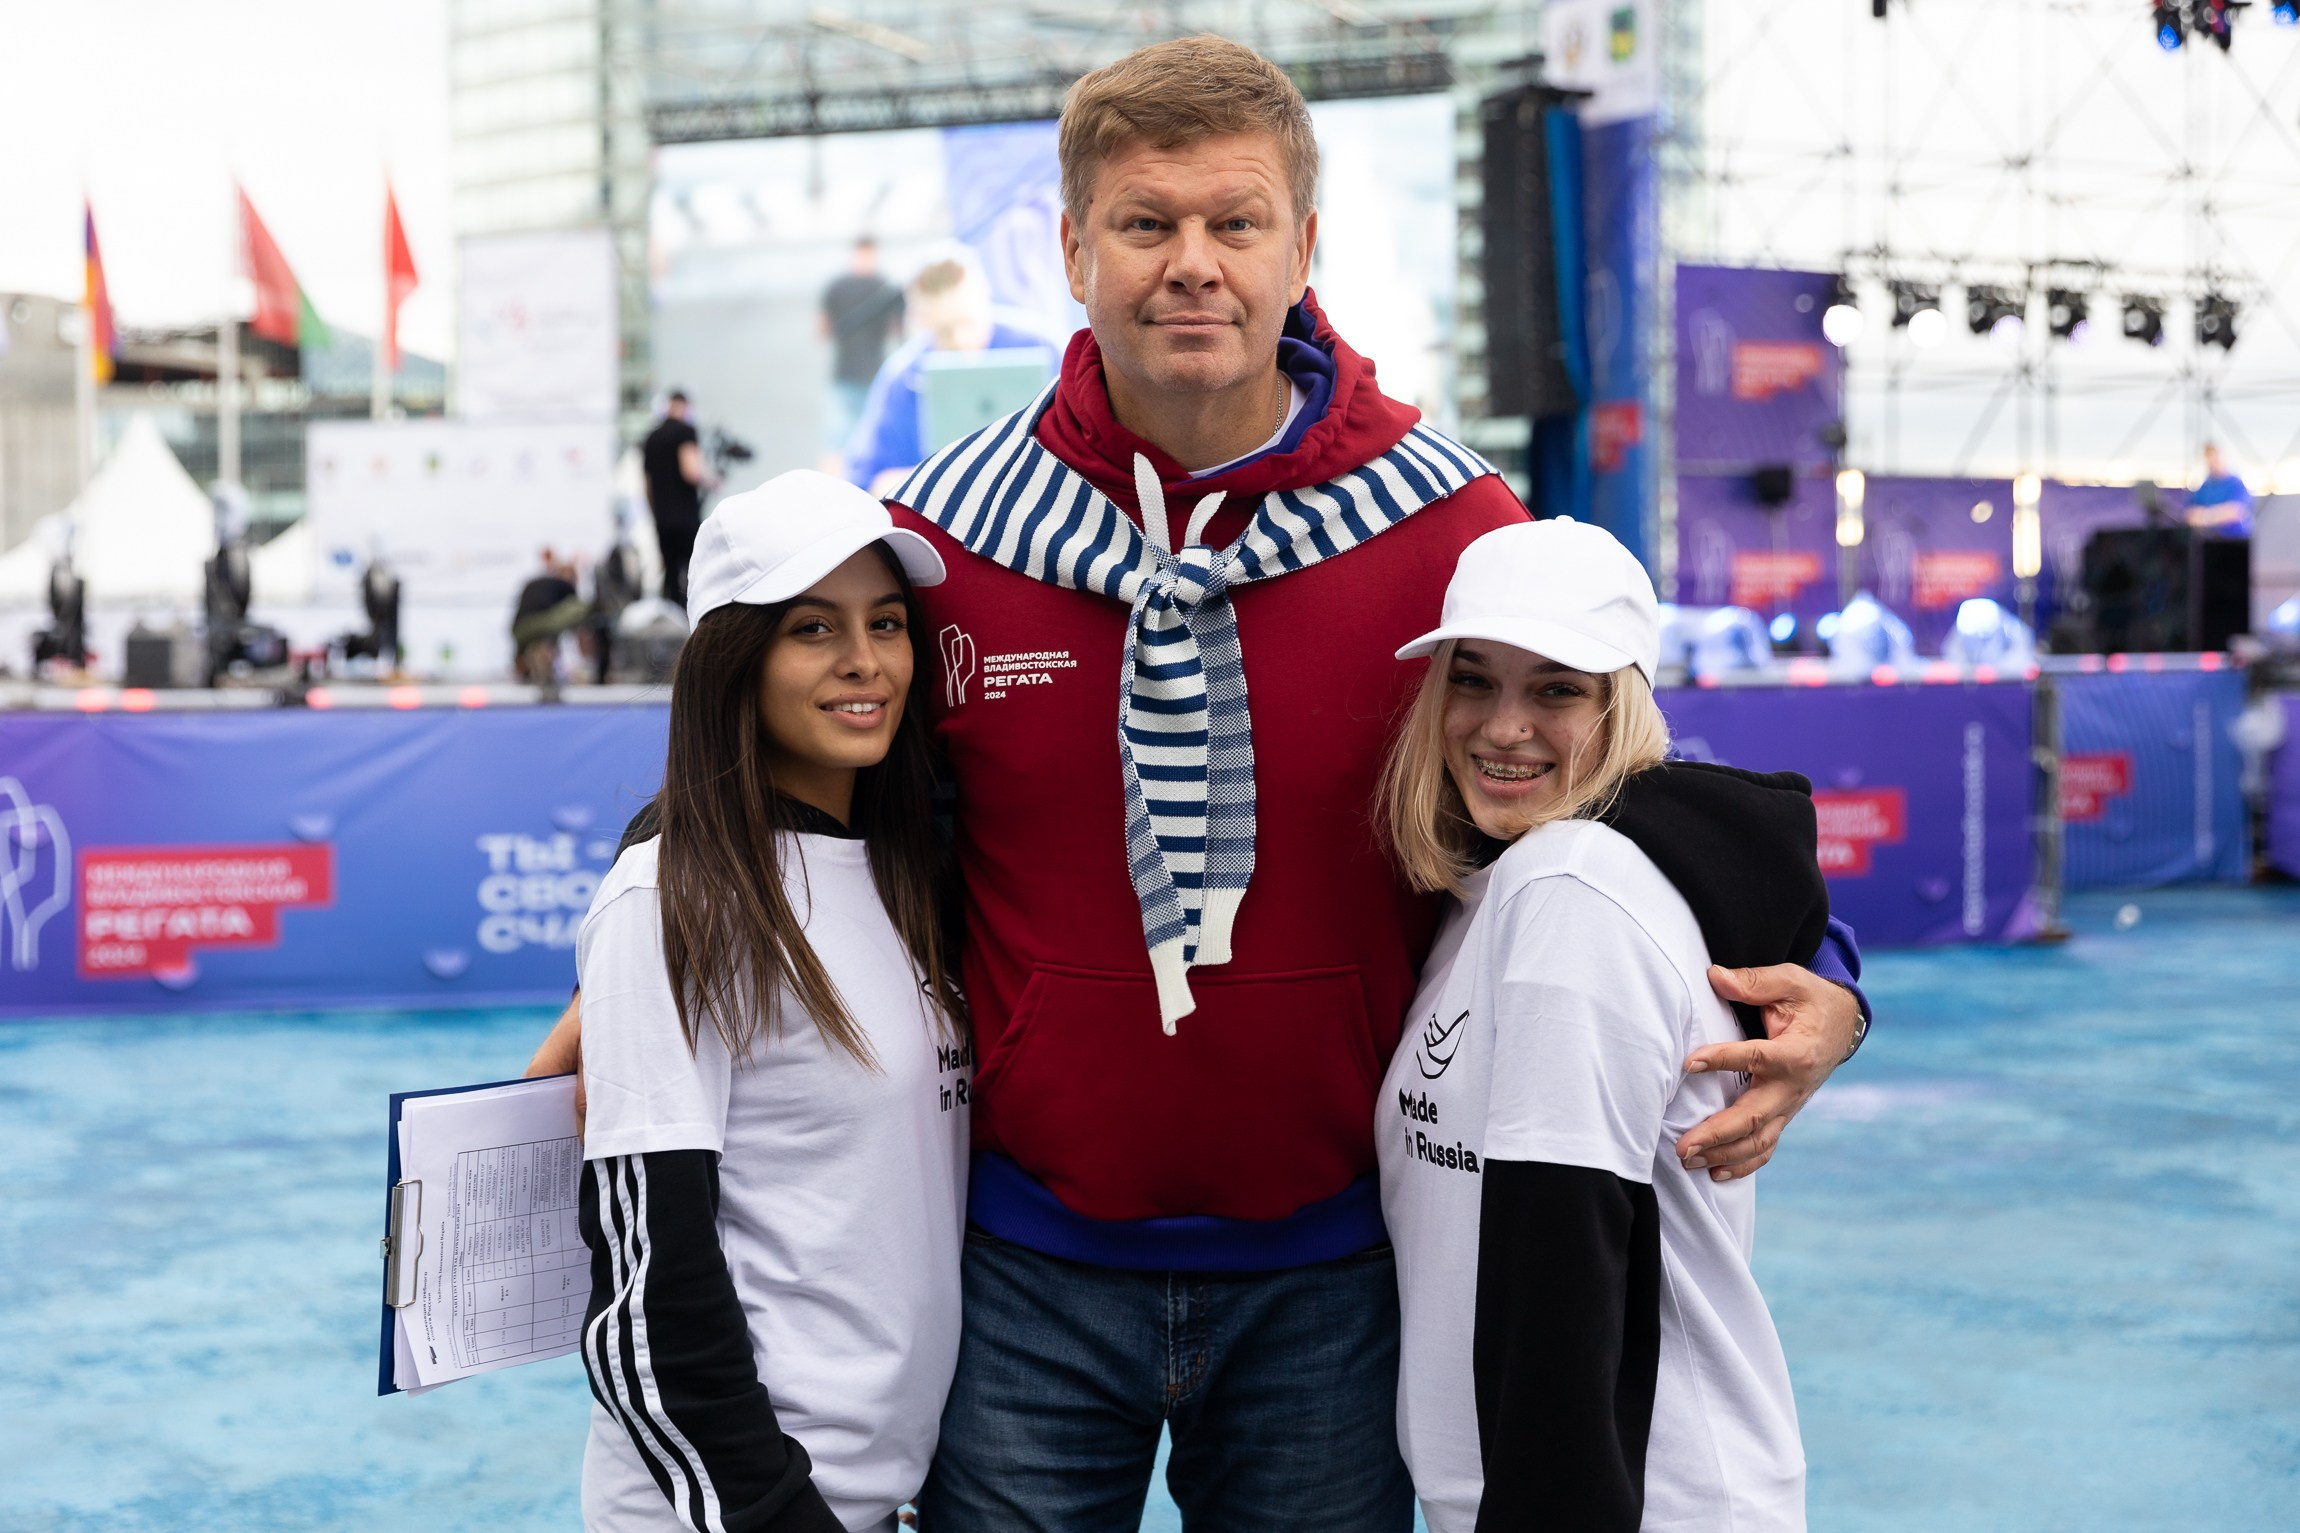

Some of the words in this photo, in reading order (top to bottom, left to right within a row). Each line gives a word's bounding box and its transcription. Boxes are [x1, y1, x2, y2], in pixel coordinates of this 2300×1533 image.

[983, 650, 1069, 664] МЕЖДУНАРОДНАЯ
[983, 660, 1077, 673] ВЛАДИВОСТОКСКАЯ
[983, 673, 1053, 688] РЕГАТА
[984, 691, 1006, 700] 2024
[477, 870, 600, 912] СВО
[85, 906, 254, 939] РЕГАТА
[940, 1084, 952, 1112] in
[1399, 1088, 1438, 1124] Made
[1405, 1127, 1413, 1158] in
[1416, 1131, 1480, 1173] Russia
